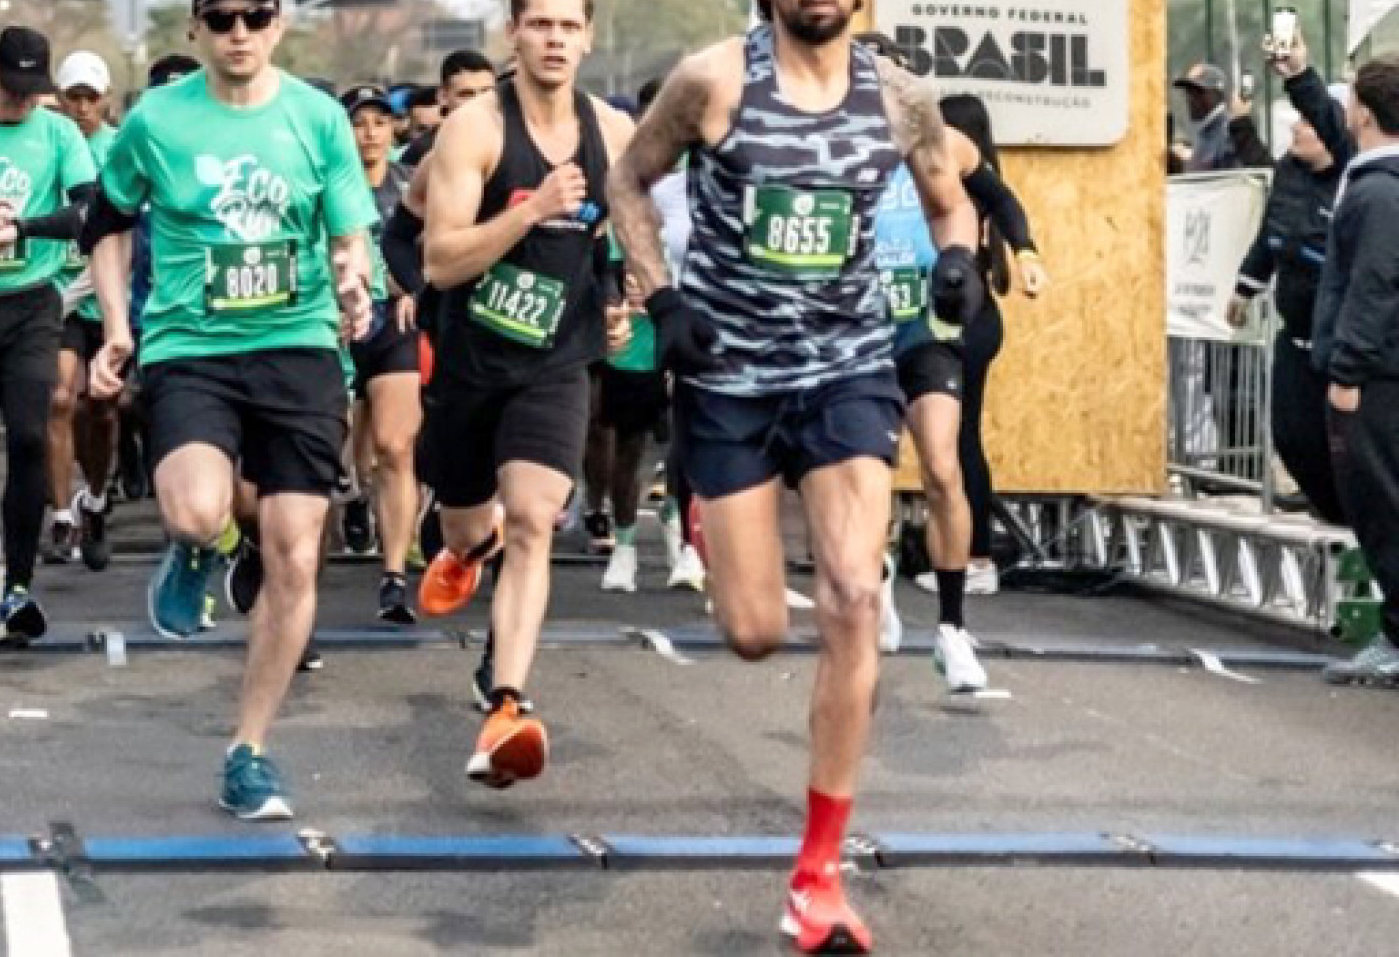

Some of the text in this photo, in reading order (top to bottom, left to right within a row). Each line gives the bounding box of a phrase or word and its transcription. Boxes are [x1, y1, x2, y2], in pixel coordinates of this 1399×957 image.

[912, 4, 1088, 25] GOVERNO FEDERAL
[895, 26, 1107, 86] BRASIL
[767, 213, 832, 255] 8655
